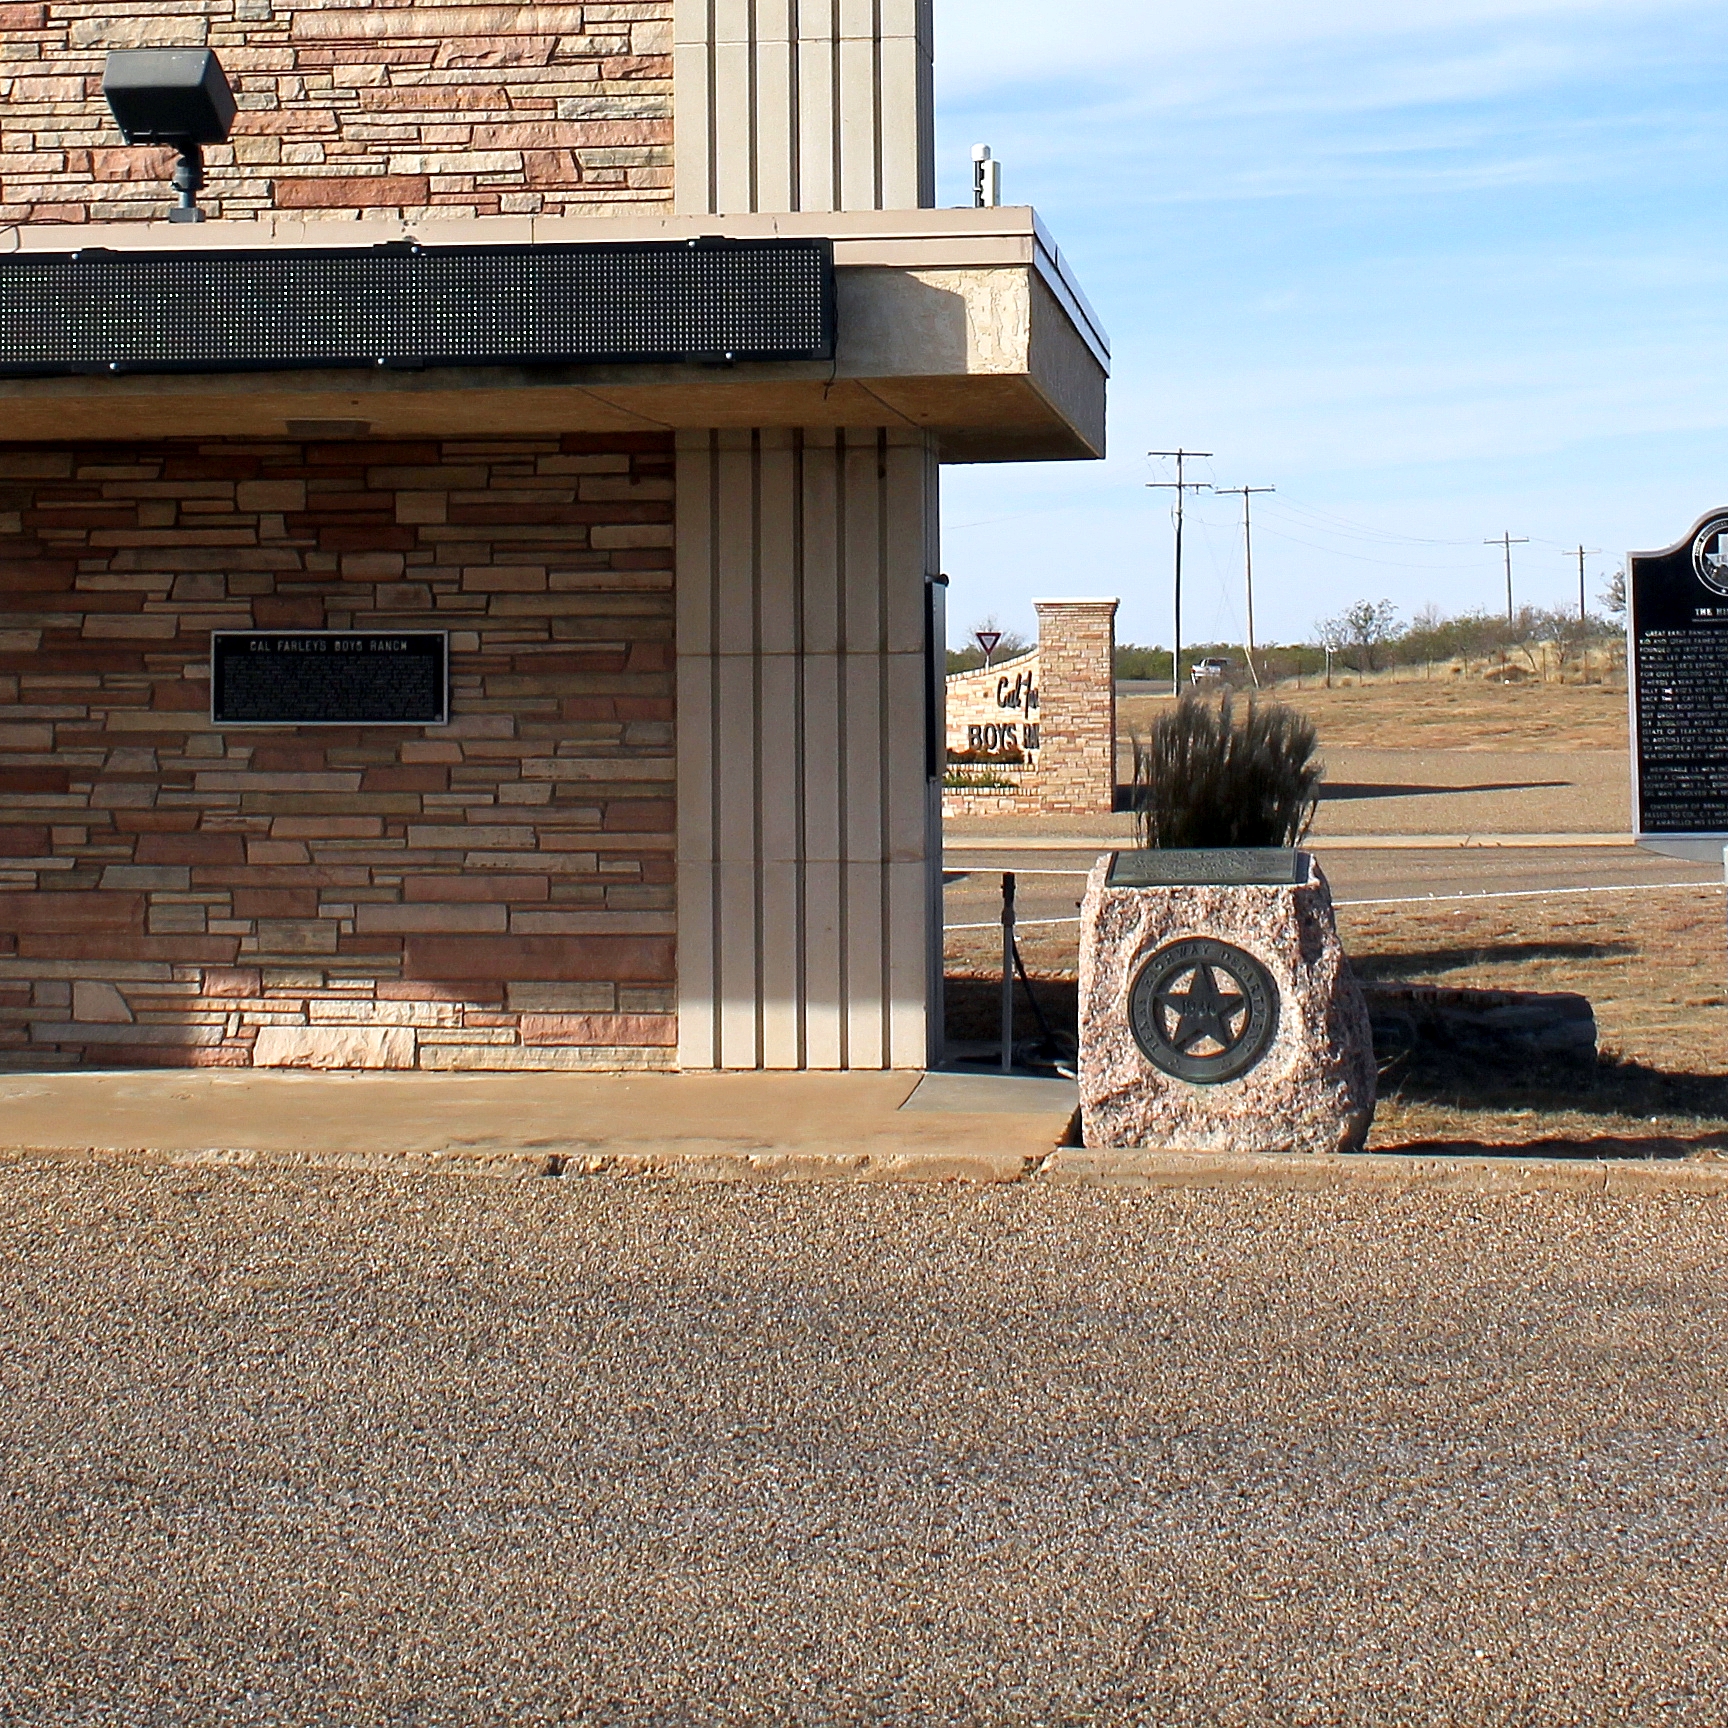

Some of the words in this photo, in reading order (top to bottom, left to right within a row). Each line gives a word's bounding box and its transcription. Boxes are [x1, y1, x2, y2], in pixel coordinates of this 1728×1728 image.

[1, 276, 180, 350] Ever
[1695, 607, 1713, 616] THE
[250, 640, 271, 652] CAL
[277, 639, 327, 652] FARLEY'S
[334, 639, 363, 652] BOYS
[370, 639, 408, 651] RANCH
[969, 723, 1017, 750] BOYS
